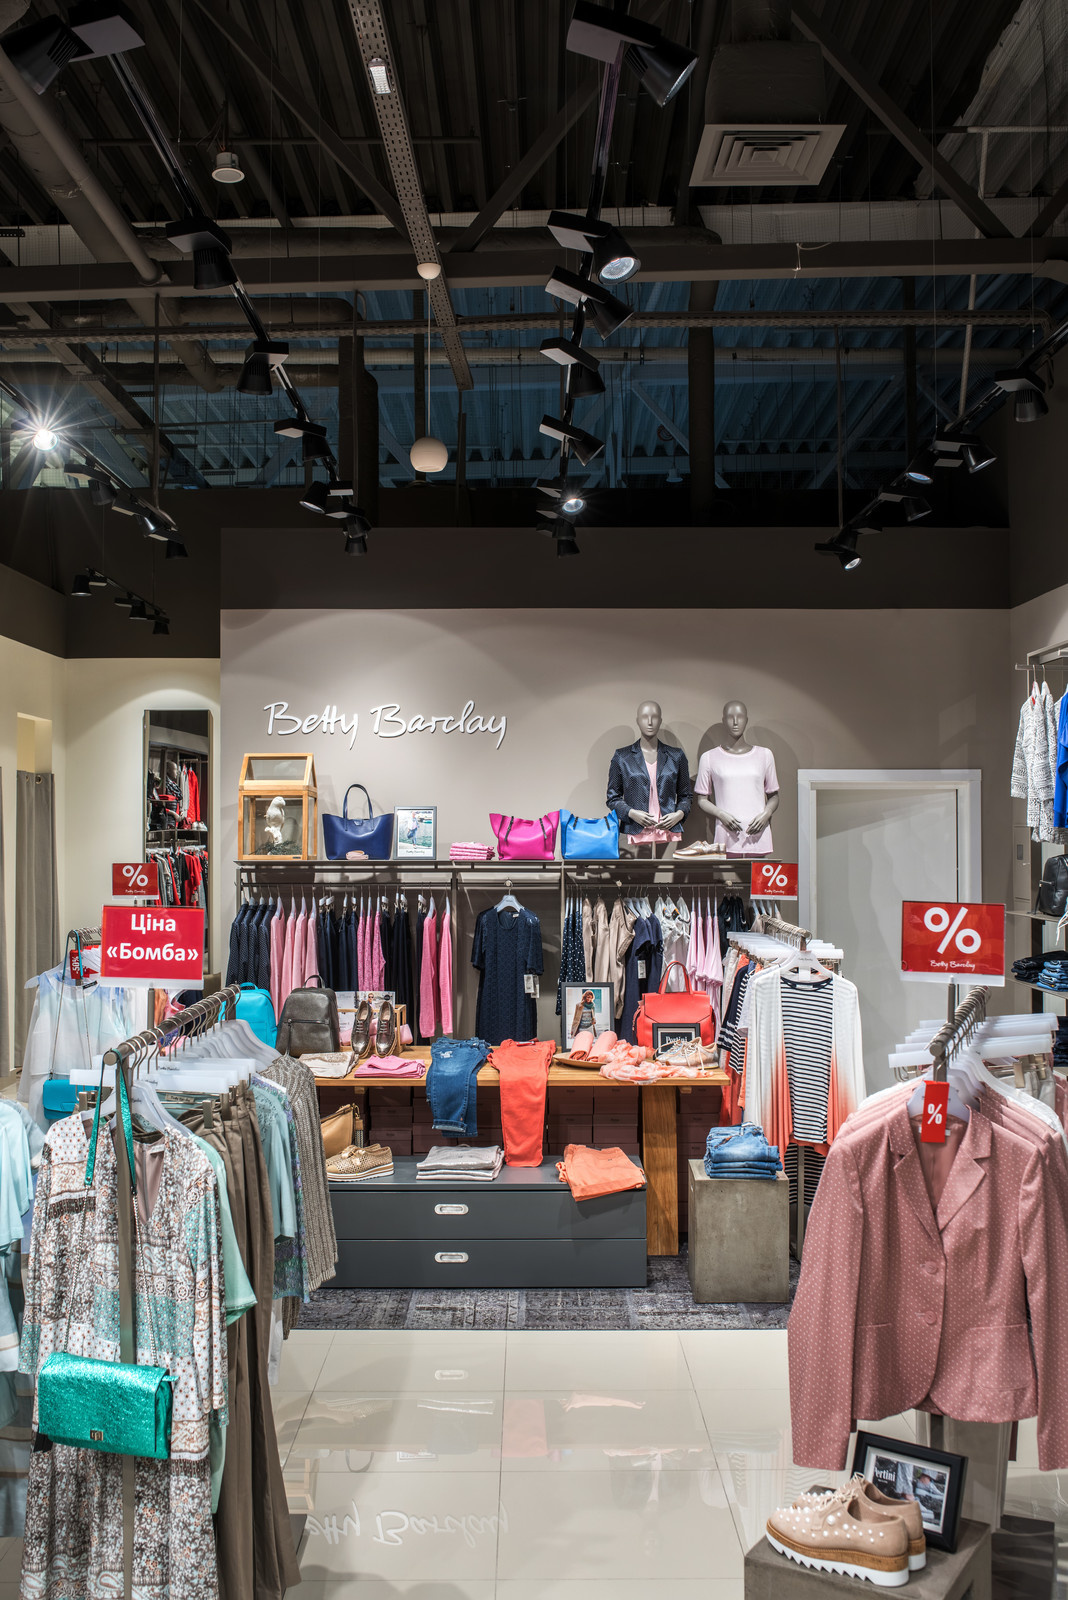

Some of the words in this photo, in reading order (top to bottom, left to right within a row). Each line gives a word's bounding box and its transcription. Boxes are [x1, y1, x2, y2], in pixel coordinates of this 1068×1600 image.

[263, 701, 358, 750] Betty
[370, 700, 507, 750] Barclay
[122, 864, 149, 887] %
[761, 864, 788, 887] %
[131, 913, 177, 935] Ціна
[923, 906, 982, 954] %
[106, 942, 199, 962] «Бомба»
[930, 960, 949, 971] Betty
[949, 960, 976, 972] Barclay
[927, 1103, 942, 1125] %
